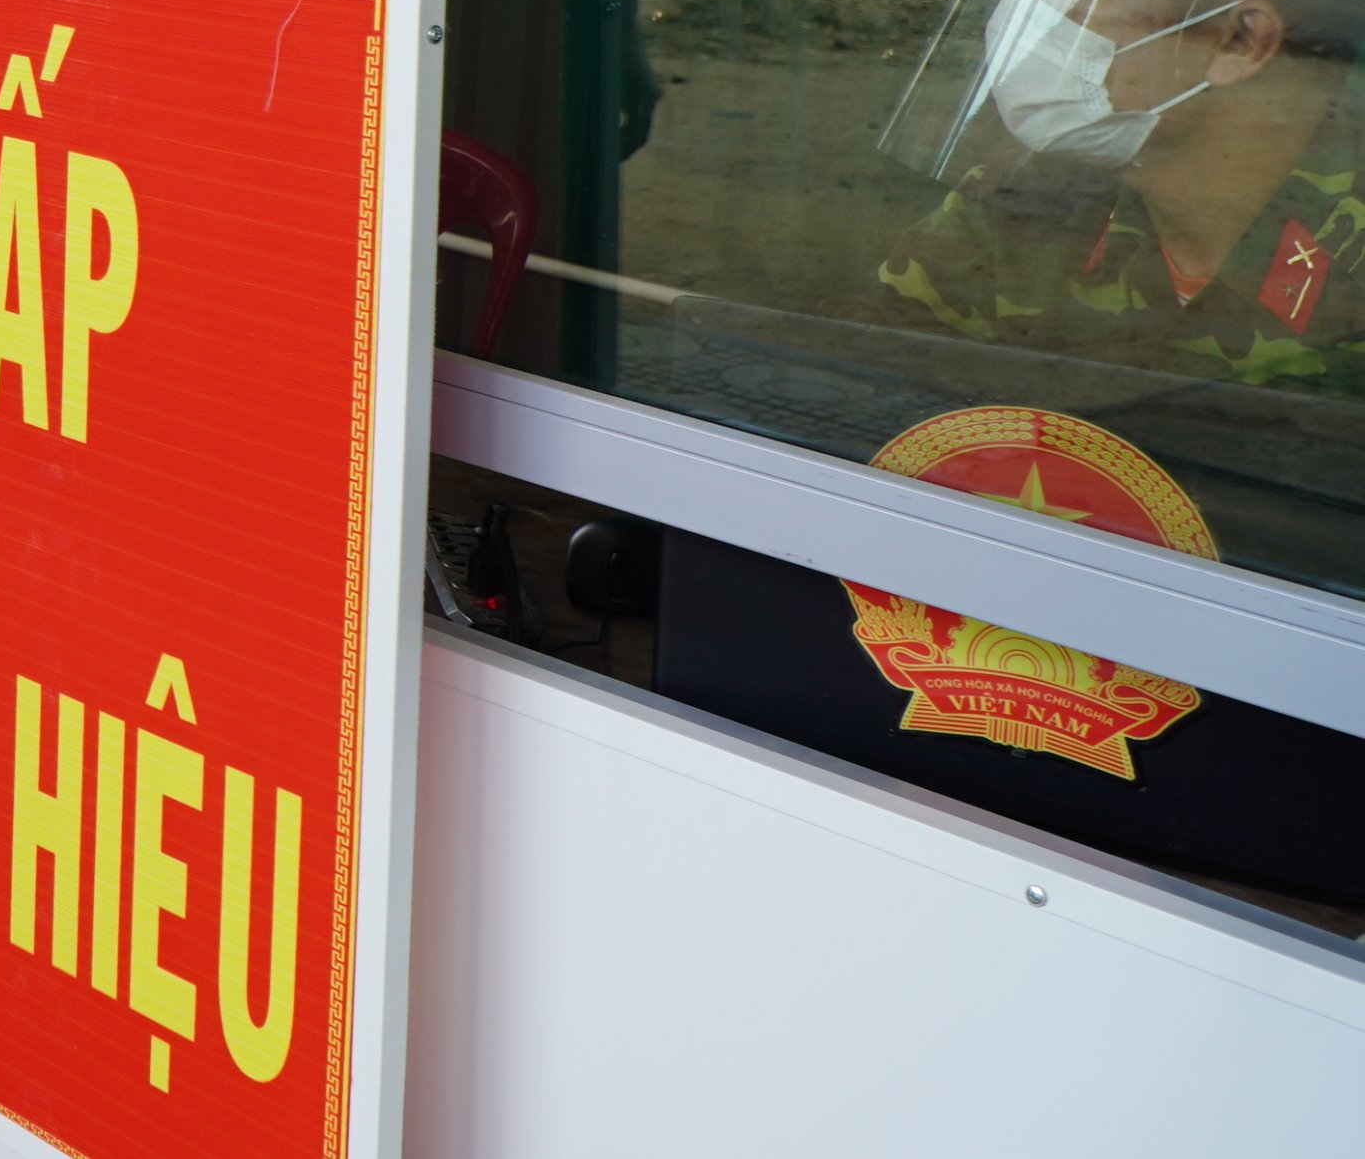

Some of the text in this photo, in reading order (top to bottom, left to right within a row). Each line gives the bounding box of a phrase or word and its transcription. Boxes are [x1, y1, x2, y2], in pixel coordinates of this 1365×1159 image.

[946, 691, 1093, 739] VIỆT NAM
[11, 654, 302, 1094] HIỆU
